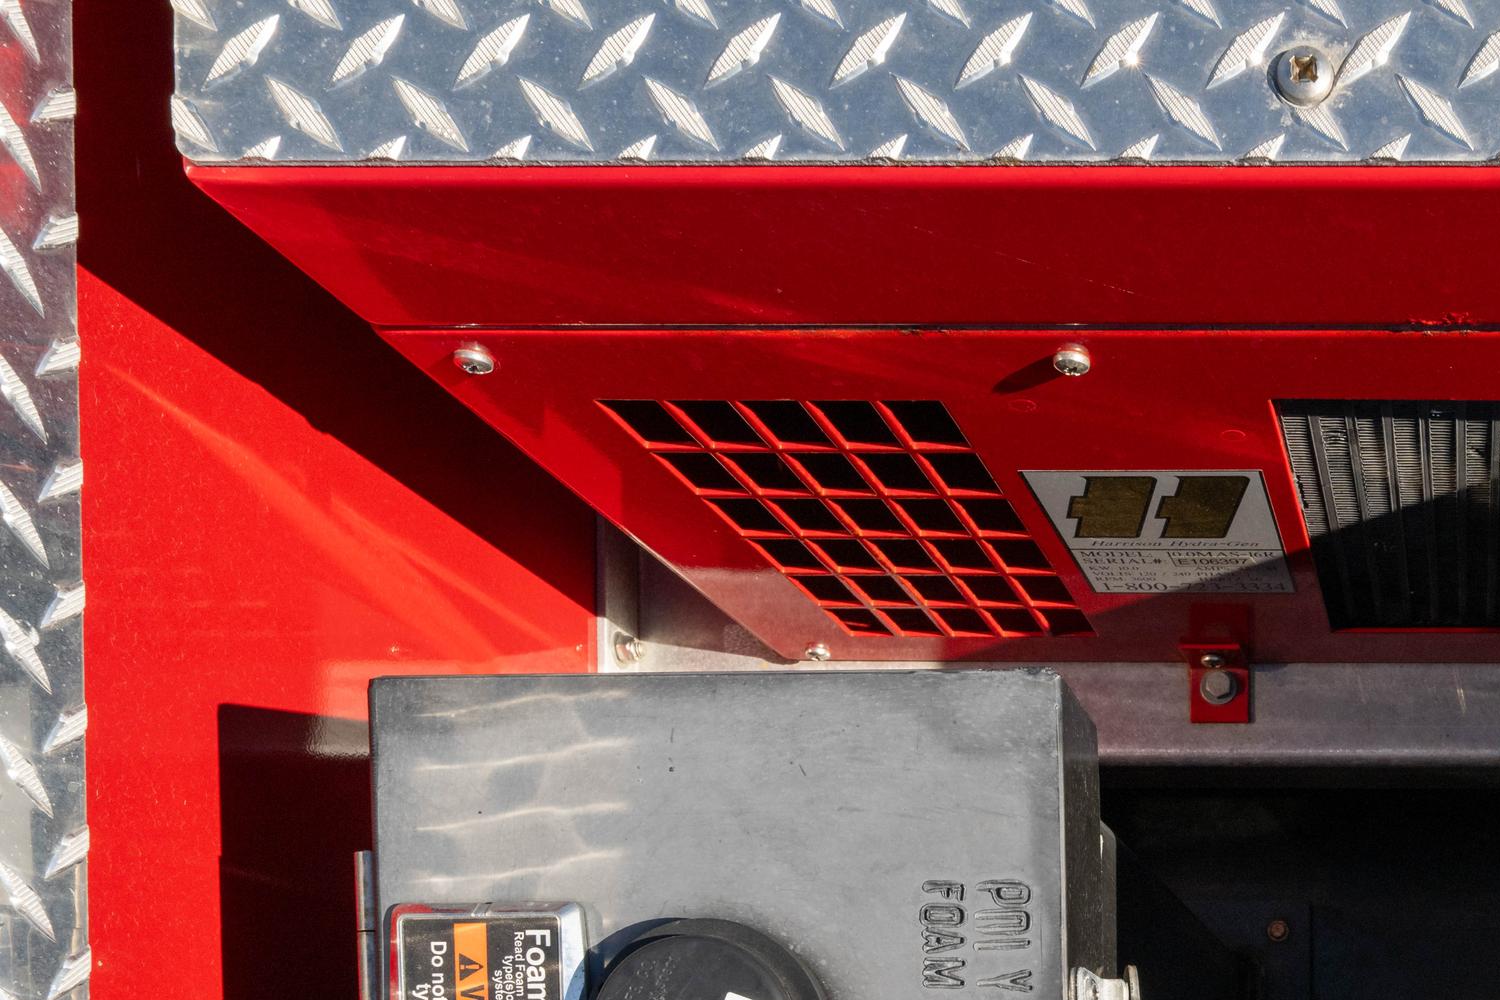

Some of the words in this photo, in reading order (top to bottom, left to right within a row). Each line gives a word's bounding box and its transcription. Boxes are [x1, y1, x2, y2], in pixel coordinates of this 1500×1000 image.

[514, 932, 525, 961] Read
[919, 880, 969, 989] FOAM
[430, 942, 447, 967] Do
[513, 965, 526, 996] Foam
